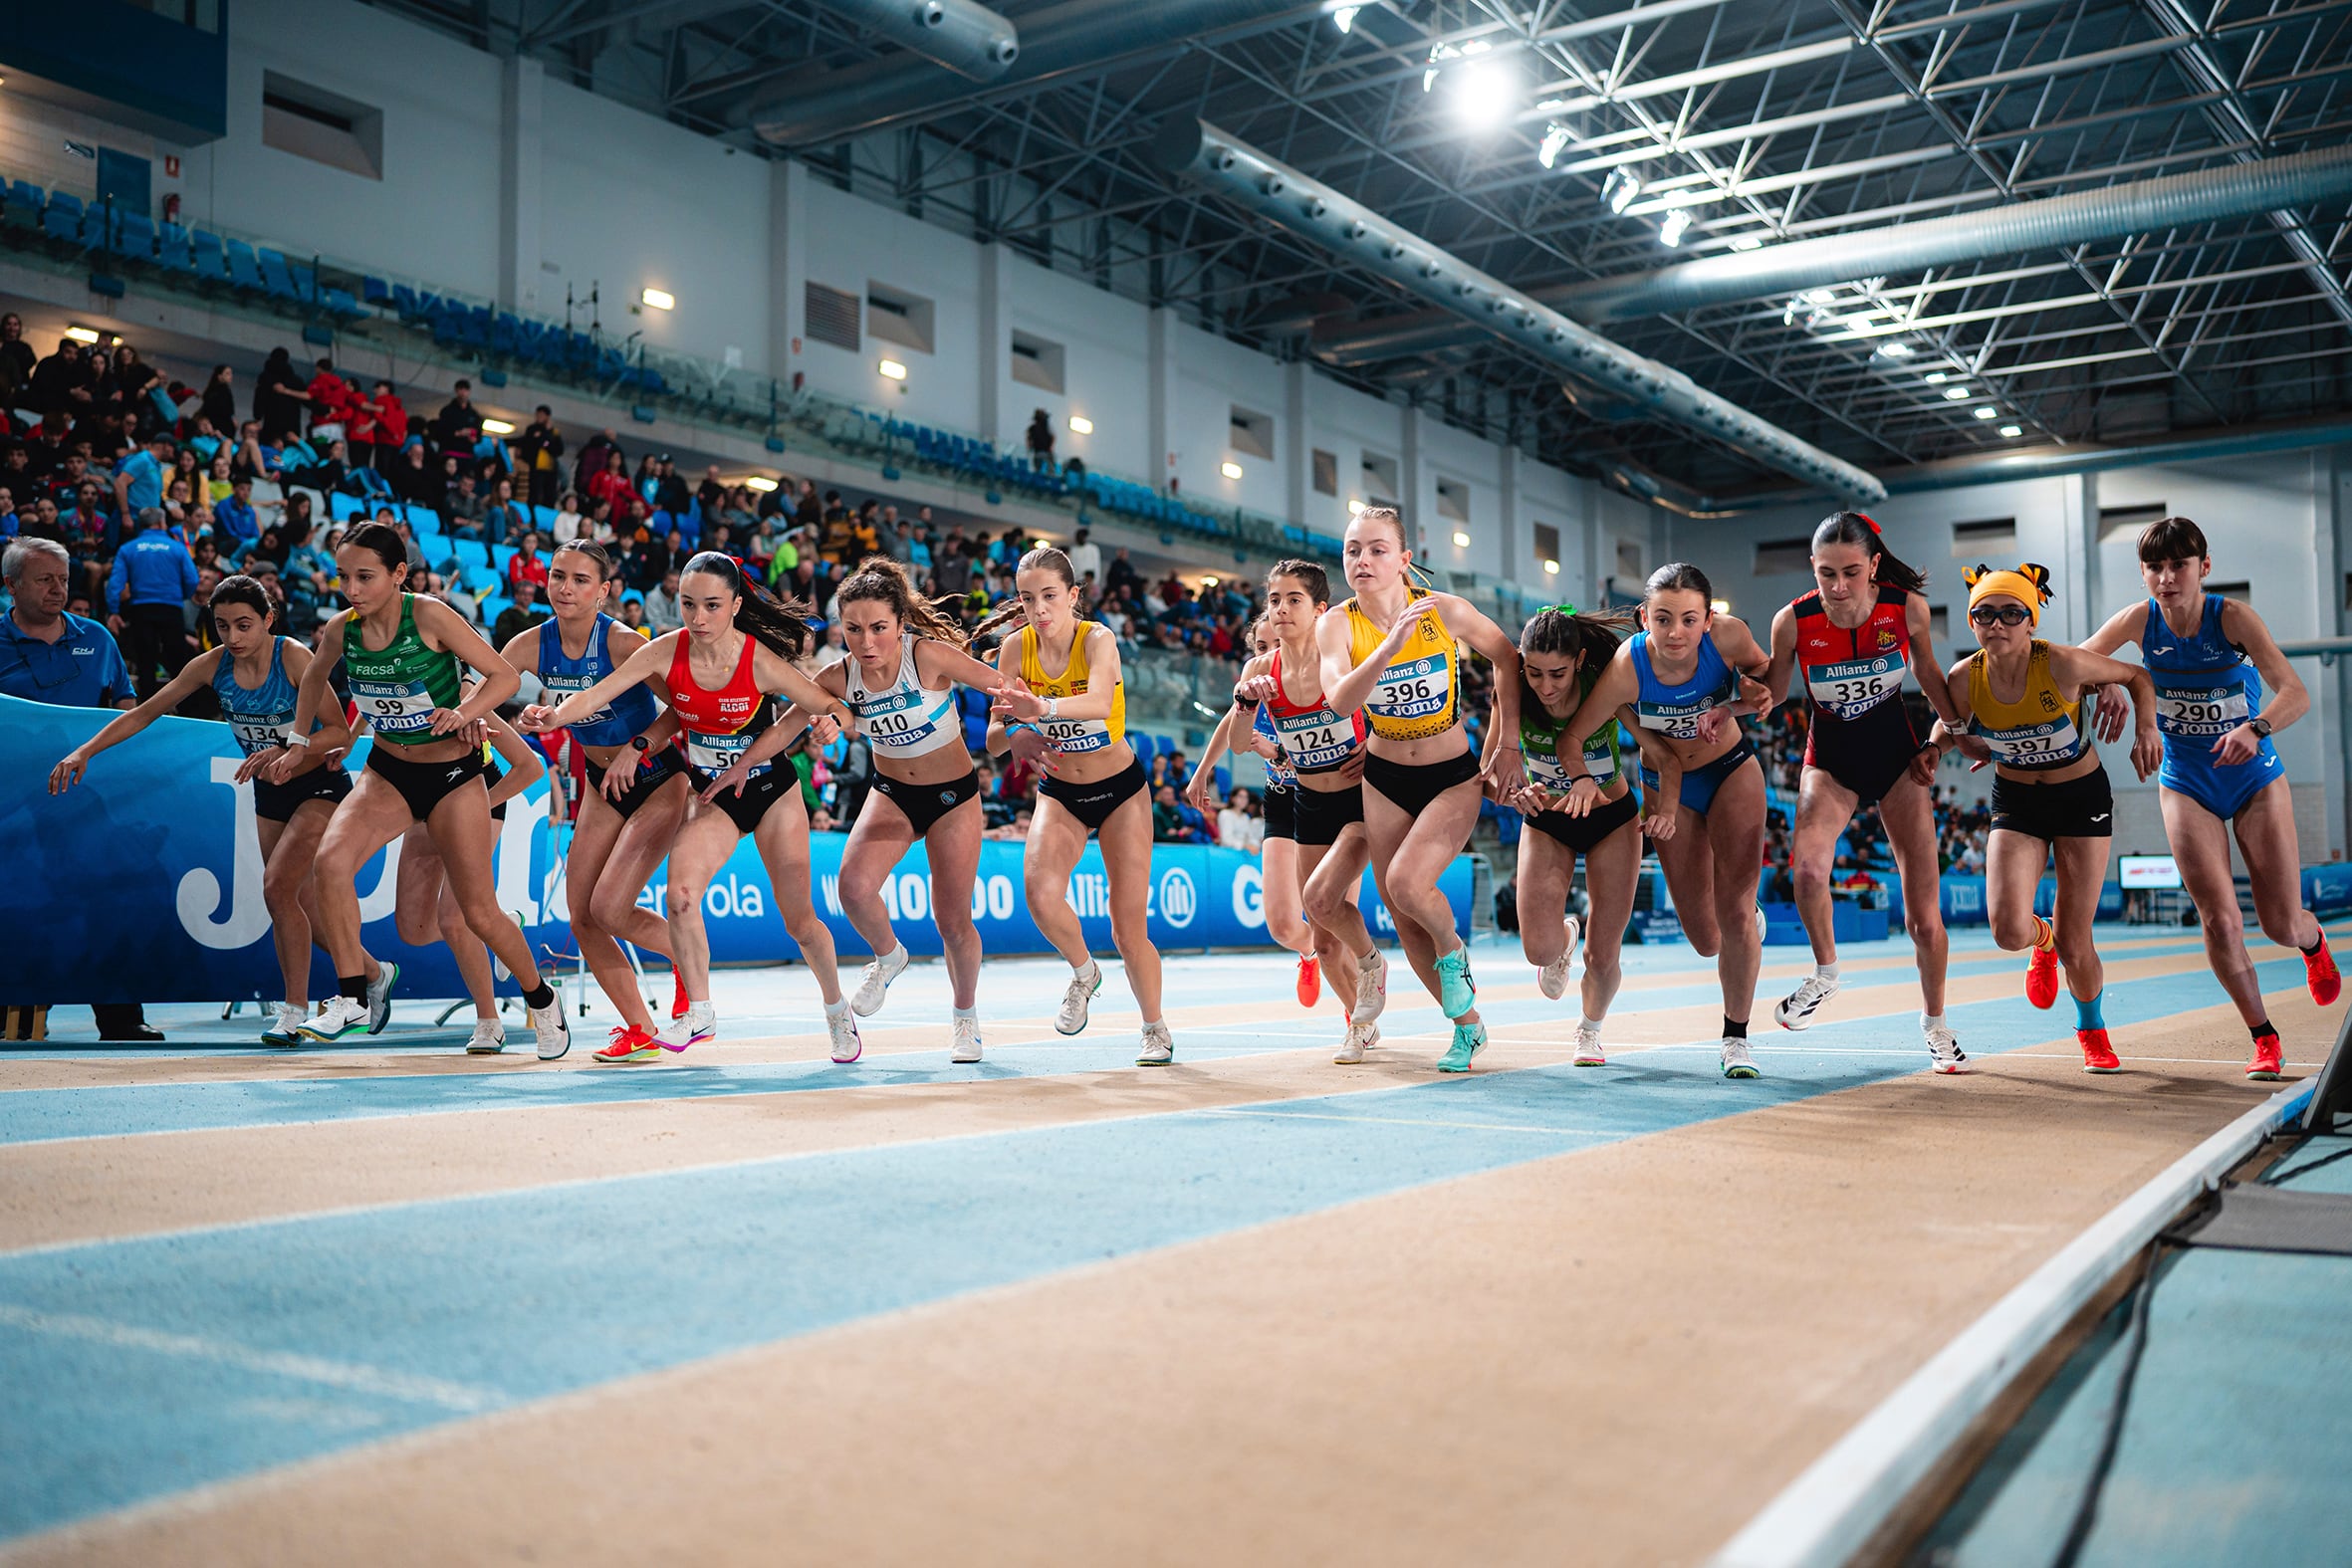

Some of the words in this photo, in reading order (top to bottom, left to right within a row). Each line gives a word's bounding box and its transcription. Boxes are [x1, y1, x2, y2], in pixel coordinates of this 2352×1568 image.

[1379, 665, 1416, 683] llianz
[1825, 664, 1870, 678] Allianz
[359, 683, 394, 696] Allianz
[547, 678, 581, 688] Allianz
[1834, 678, 1884, 703] 336
[1382, 679, 1431, 704] 396
[2166, 688, 2209, 701] Allianz
[374, 699, 404, 715] 99
[859, 702, 893, 717] Allianz
[1656, 704, 1700, 715] Allianz
[2174, 702, 2223, 722] 290
[232, 714, 267, 725] Allianz
[869, 713, 908, 736] 410
[1282, 716, 1320, 731] Allianz
[242, 726, 282, 741] 134
[1047, 723, 1085, 740] 406
[1993, 730, 2037, 740] Allianz
[701, 736, 738, 748] Allianz
[1293, 728, 1336, 752] 124
[2003, 737, 2052, 755] 397
